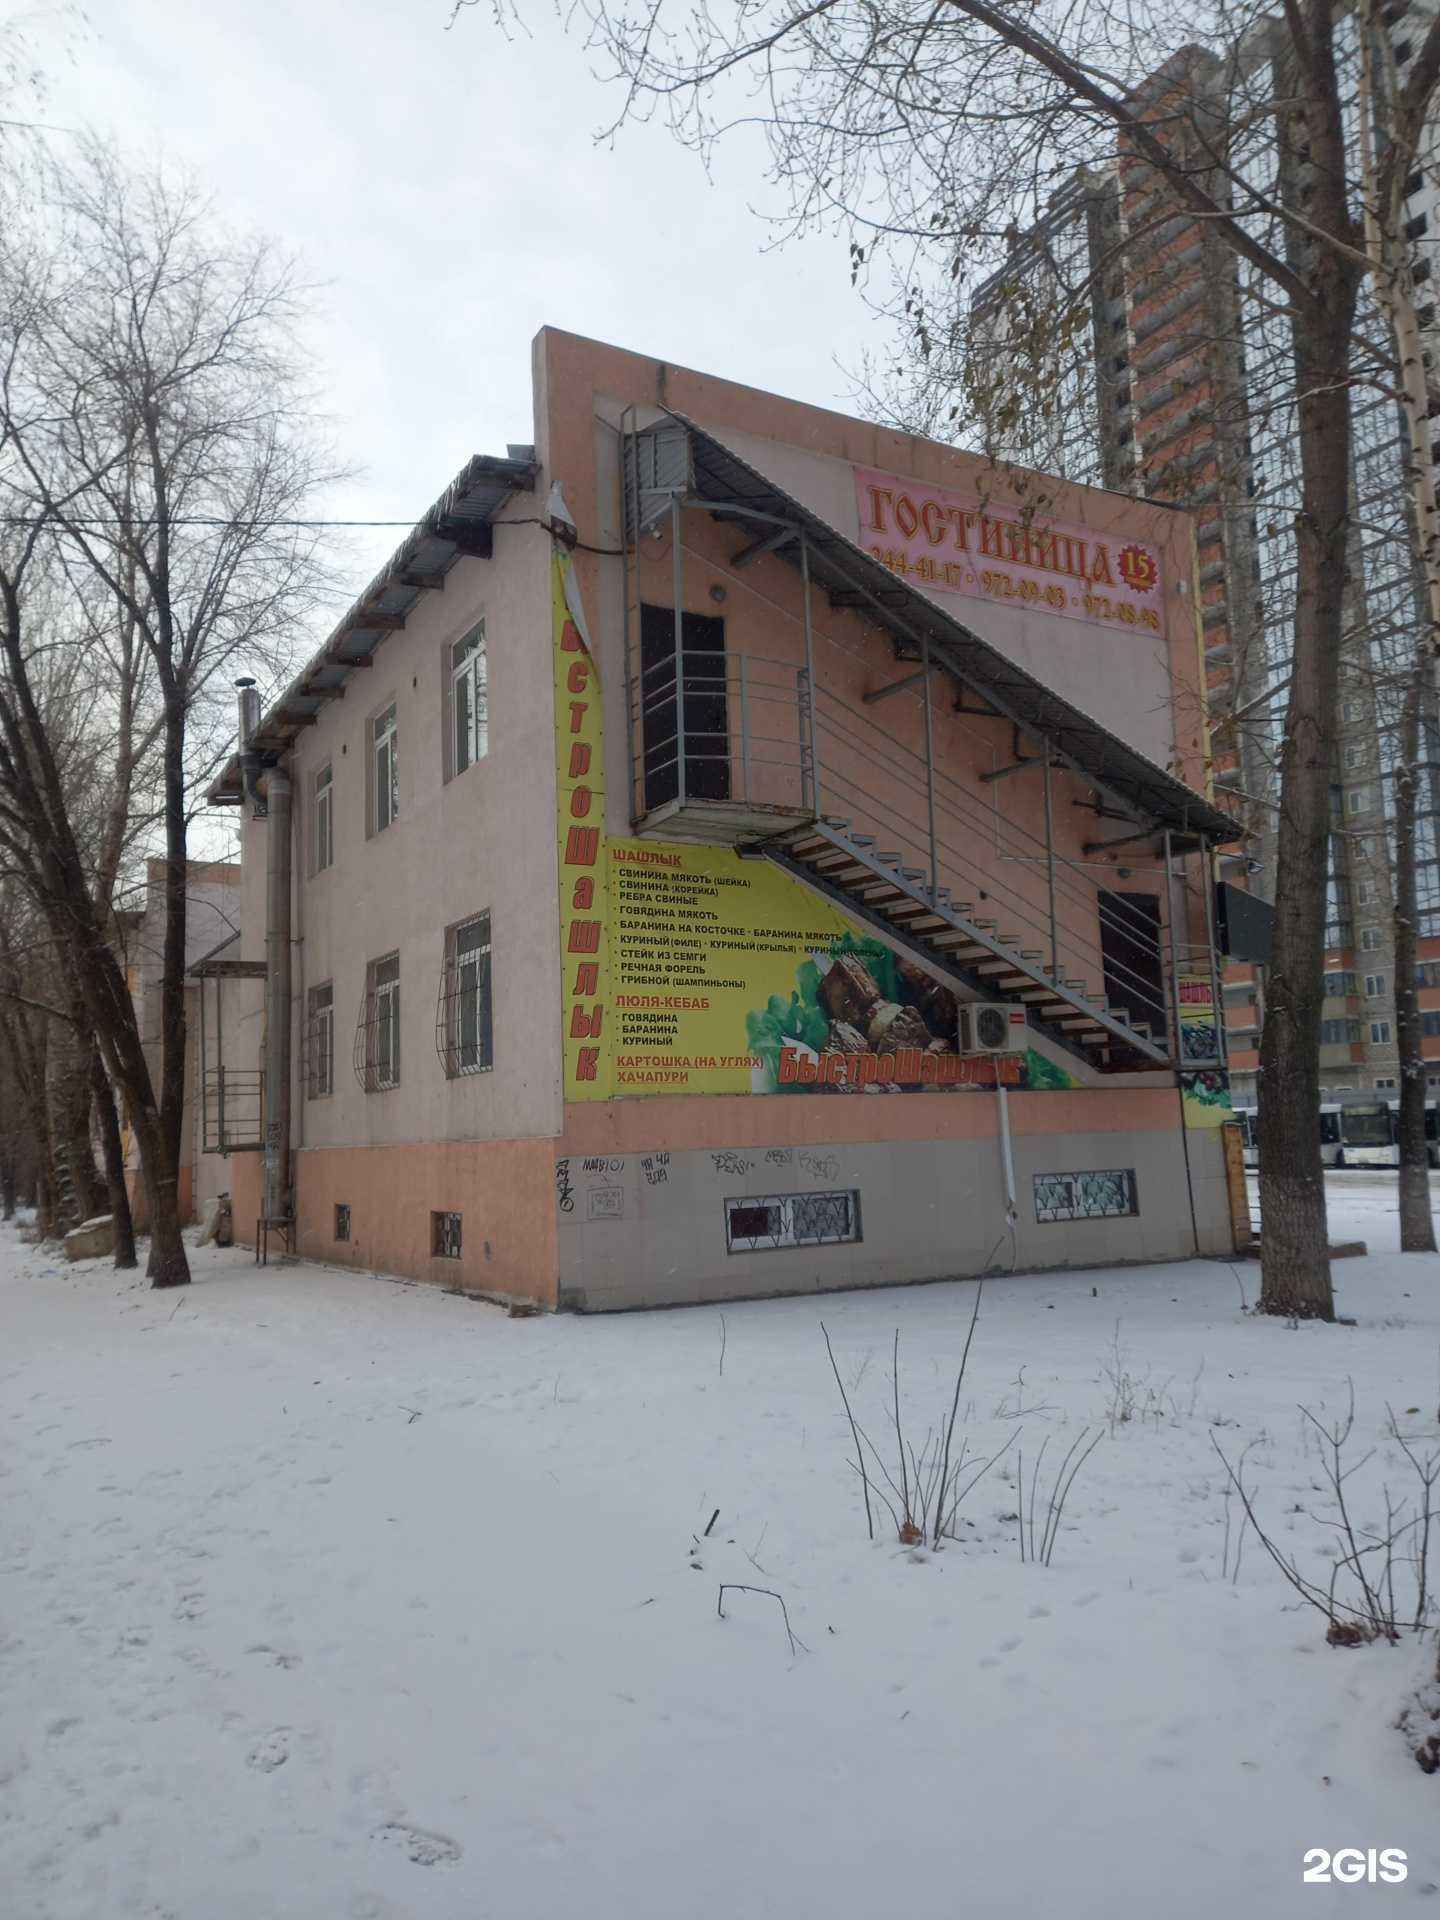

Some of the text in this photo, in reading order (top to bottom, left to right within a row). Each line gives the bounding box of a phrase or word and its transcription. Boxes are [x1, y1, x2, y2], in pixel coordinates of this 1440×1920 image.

[869, 484, 1117, 591] ГОСТИНИЦА
[1125, 552, 1150, 578] 15
[613, 848, 682, 866] ШАШЛЫК
[619, 868, 751, 888] СВИНИНА МЯКОТЬ (ШЕЙКА)
[619, 880, 669, 892] СВИНИНА
[619, 892, 698, 905] РЕБРА СВИНЫЕ
[619, 906, 718, 920] ГОВЯДИНА МЯКОТЬ
[620, 920, 842, 941] БАРАНИНА НА КОСТОЧКЕ БАРАНИНА МЯКОТЬ
[621, 949, 707, 961] СТЕЙК ИЗ СЕМГИ
[621, 963, 706, 974] РЕЧНАЯ ФОРЕЛЬ
[621, 975, 746, 990] ГРИБНОЙ (ШАМПИНЬОНЫ)
[616, 995, 710, 1009] ЛЮЛЯ-КЕБАБ
[622, 1013, 678, 1024] ГОВЯДИНА
[622, 1025, 678, 1035] БАРАНИНА
[622, 1036, 673, 1046] КУРИНЫЙ
[617, 1056, 764, 1069] КАРТОШКА (НА УГЛЯХ)
[617, 1071, 689, 1083] ХАЧАПУРИ
